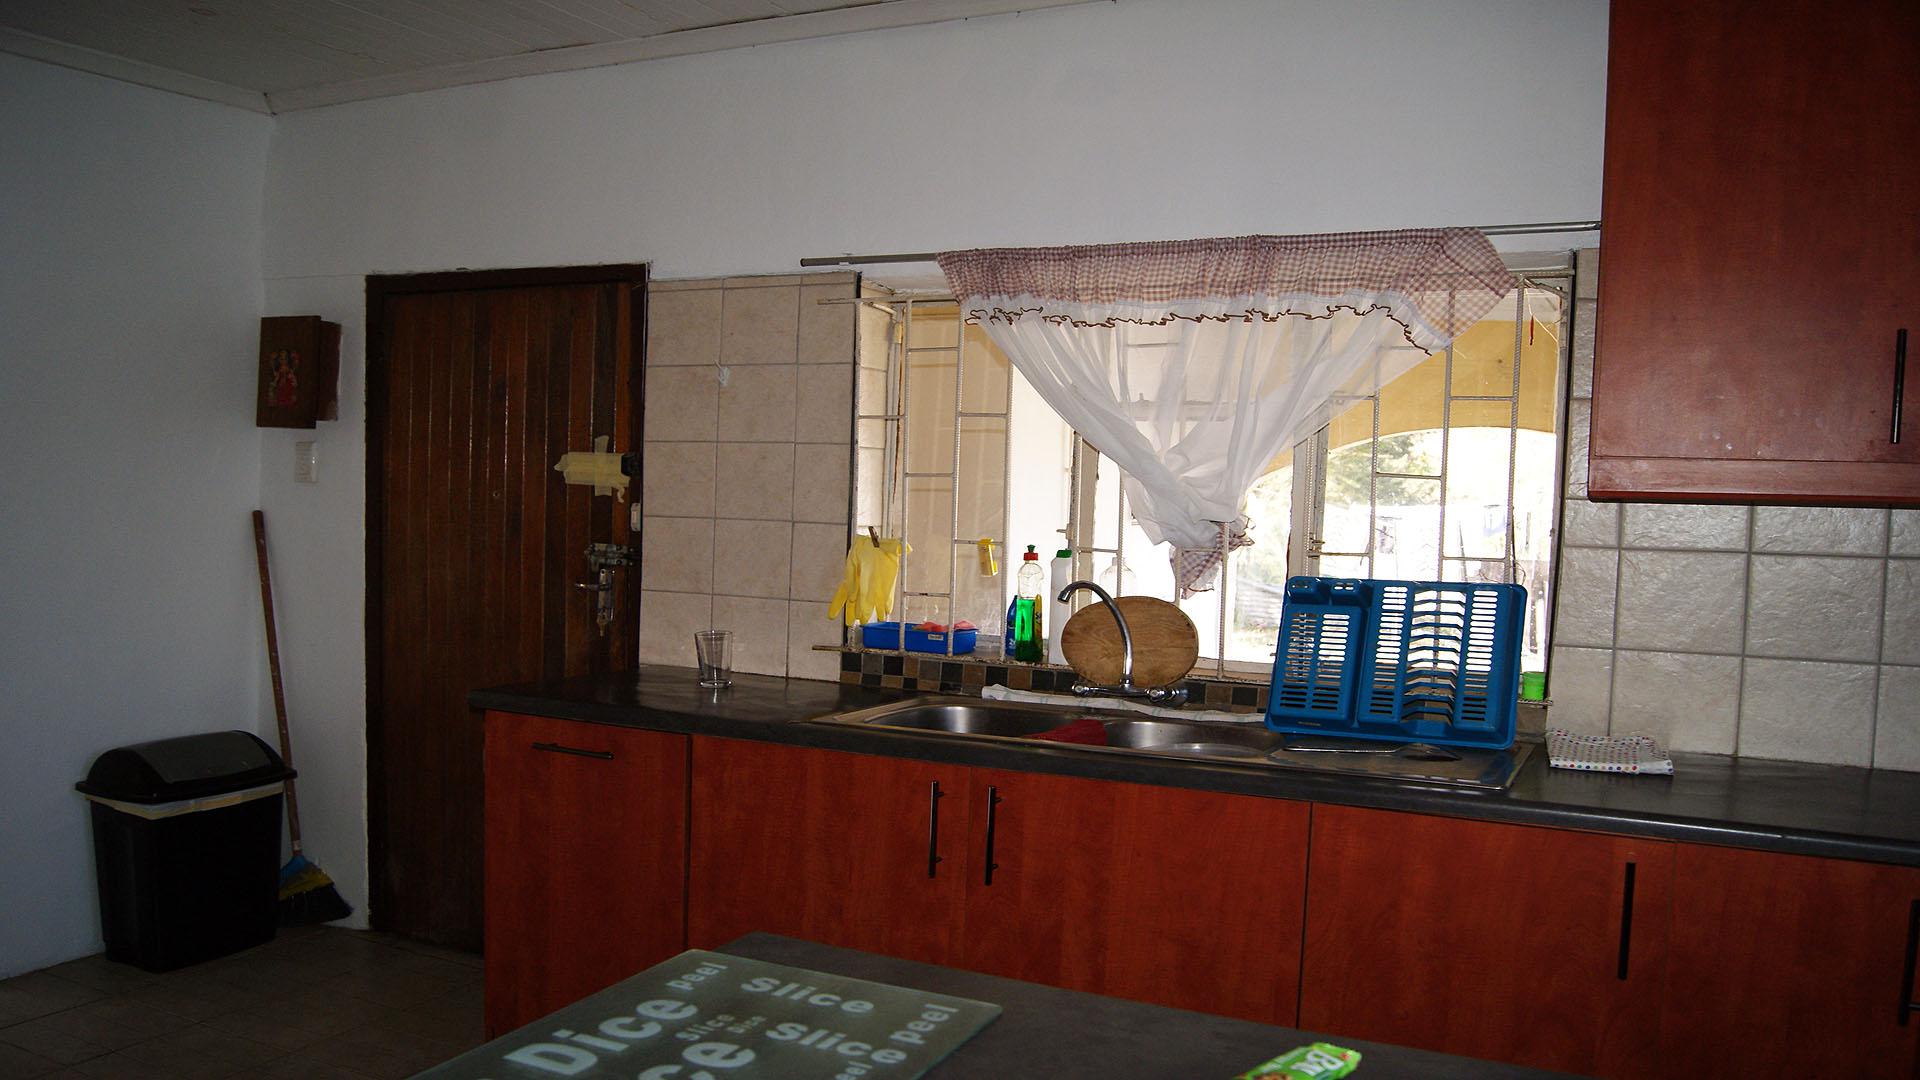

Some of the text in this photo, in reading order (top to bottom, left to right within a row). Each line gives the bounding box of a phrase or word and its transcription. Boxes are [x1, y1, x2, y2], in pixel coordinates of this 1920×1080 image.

[664, 961, 729, 991] peel
[740, 977, 875, 1013] Slice
[503, 999, 699, 1076] Dice
[674, 1014, 736, 1041] Slice
[889, 1003, 960, 1045] peel
[637, 1041, 756, 1080] ce
[765, 1022, 908, 1064] Slice
[834, 1060, 873, 1080] eel
